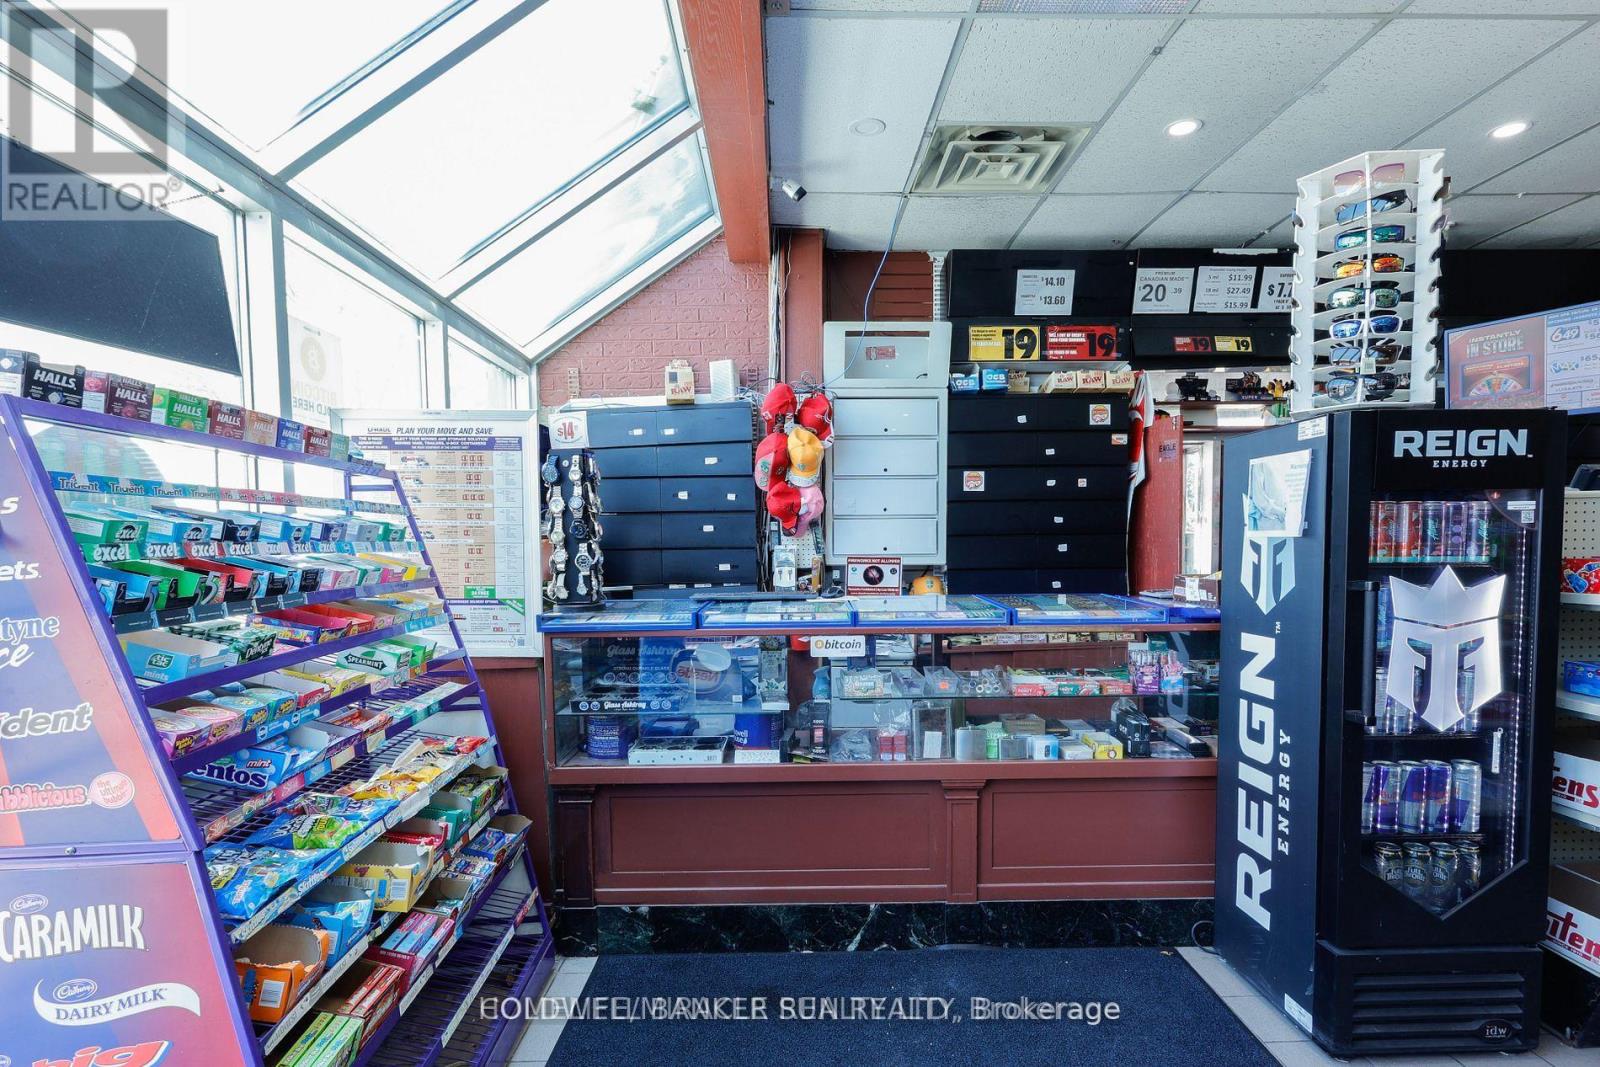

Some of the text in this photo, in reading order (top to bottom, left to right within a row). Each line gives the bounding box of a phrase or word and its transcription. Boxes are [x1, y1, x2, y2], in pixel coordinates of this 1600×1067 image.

[1228, 273, 1253, 282] $11.99
[1226, 287, 1251, 295] $27.49
[1224, 301, 1249, 309] $15.99
[1469, 329, 1521, 343] INSTANTLY
[1002, 328, 1038, 360] 19
[1087, 333, 1116, 357] 19
[1192, 337, 1209, 351] 19
[1235, 339, 1250, 351] 19
[1467, 335, 1525, 358] IN STORE
[33, 369, 77, 391] HALLS
[1057, 376, 1074, 384] RAW
[1082, 376, 1103, 385] RAW
[1112, 376, 1132, 385] RAW
[115, 387, 148, 404] HALLS
[173, 403, 202, 417] HALLS
[216, 412, 241, 427] HALLS
[253, 420, 275, 433] HALLS
[282, 428, 301, 440] HALLS
[396, 427, 415, 435] PLAN
[417, 427, 435, 435] YOUR
[437, 427, 457, 435] MOVE
[459, 427, 474, 435] AND
[475, 427, 494, 435] SAVE
[309, 435, 329, 447] HALLS
[1393, 429, 1529, 458] REIGN
[1432, 459, 1488, 468] ENERGY
[114, 525, 140, 541] excel
[93, 543, 131, 563] excel
[146, 543, 180, 558] excel
[191, 542, 219, 557] excel
[229, 541, 254, 555] excel
[0, 616, 60, 646] tyne
[825, 639, 862, 650] bitcoin
[347, 654, 384, 671] SPEARMINT
[604, 700, 647, 710] Glass Ashtray
[0, 703, 93, 738] dent
[245, 759, 272, 768] mint
[193, 764, 267, 788] entos
[1235, 632, 1276, 932] REIGN
[1277, 729, 1291, 856] ENERGY
[1553, 774, 1600, 809] ens
[0, 904, 145, 963] CARAMILK
[57, 982, 95, 999] Cadbury
[55, 989, 166, 1021] DAIRY MILK
[1486, 1025, 1507, 1036] idw
